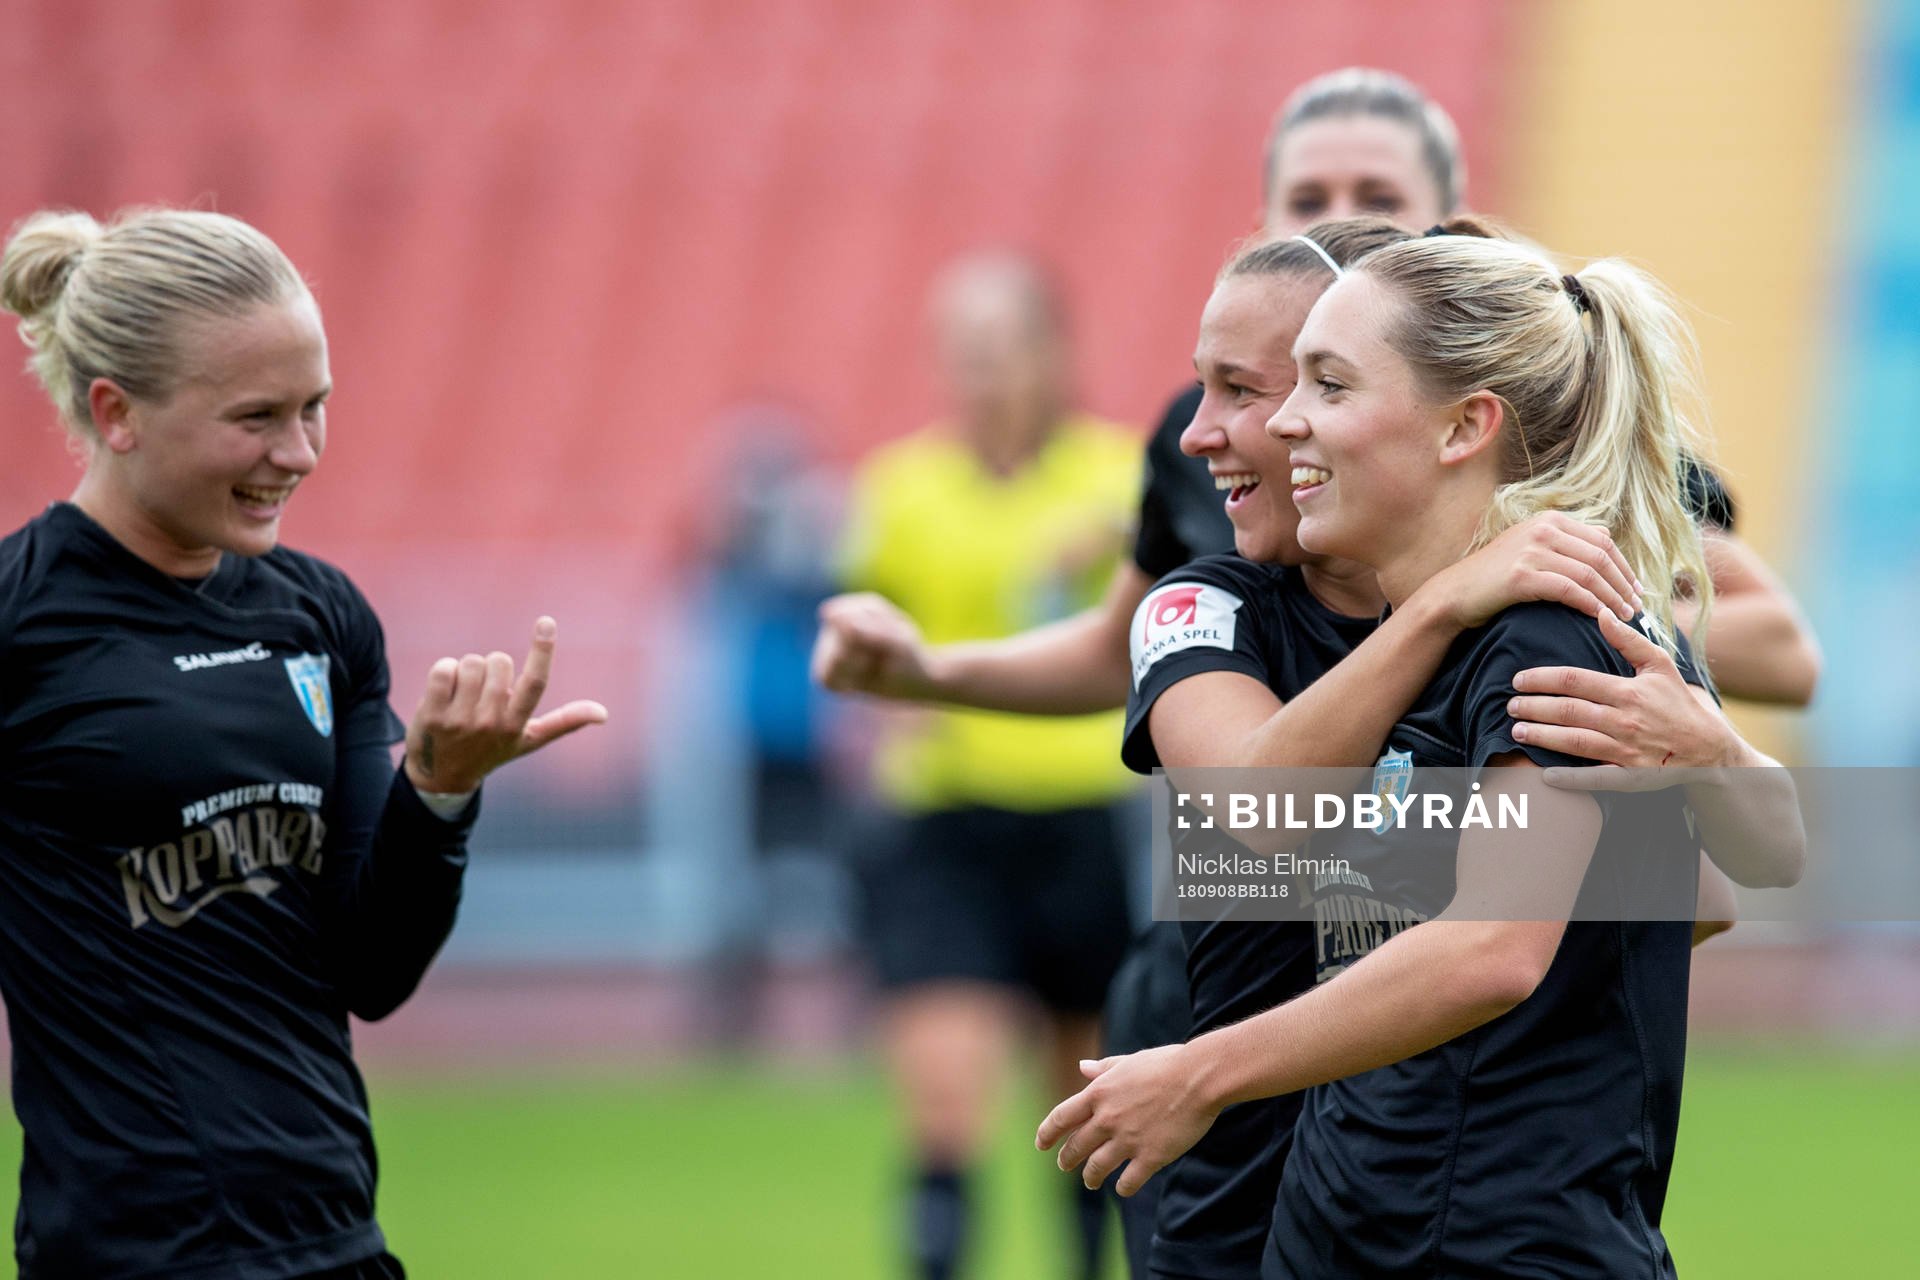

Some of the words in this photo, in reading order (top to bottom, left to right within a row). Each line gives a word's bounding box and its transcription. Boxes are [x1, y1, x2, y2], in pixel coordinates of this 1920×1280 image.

[1184, 629, 1221, 640] SPEL
[181, 784, 276, 828] PREMIUM
[1340, 868, 1374, 892] CIDER
